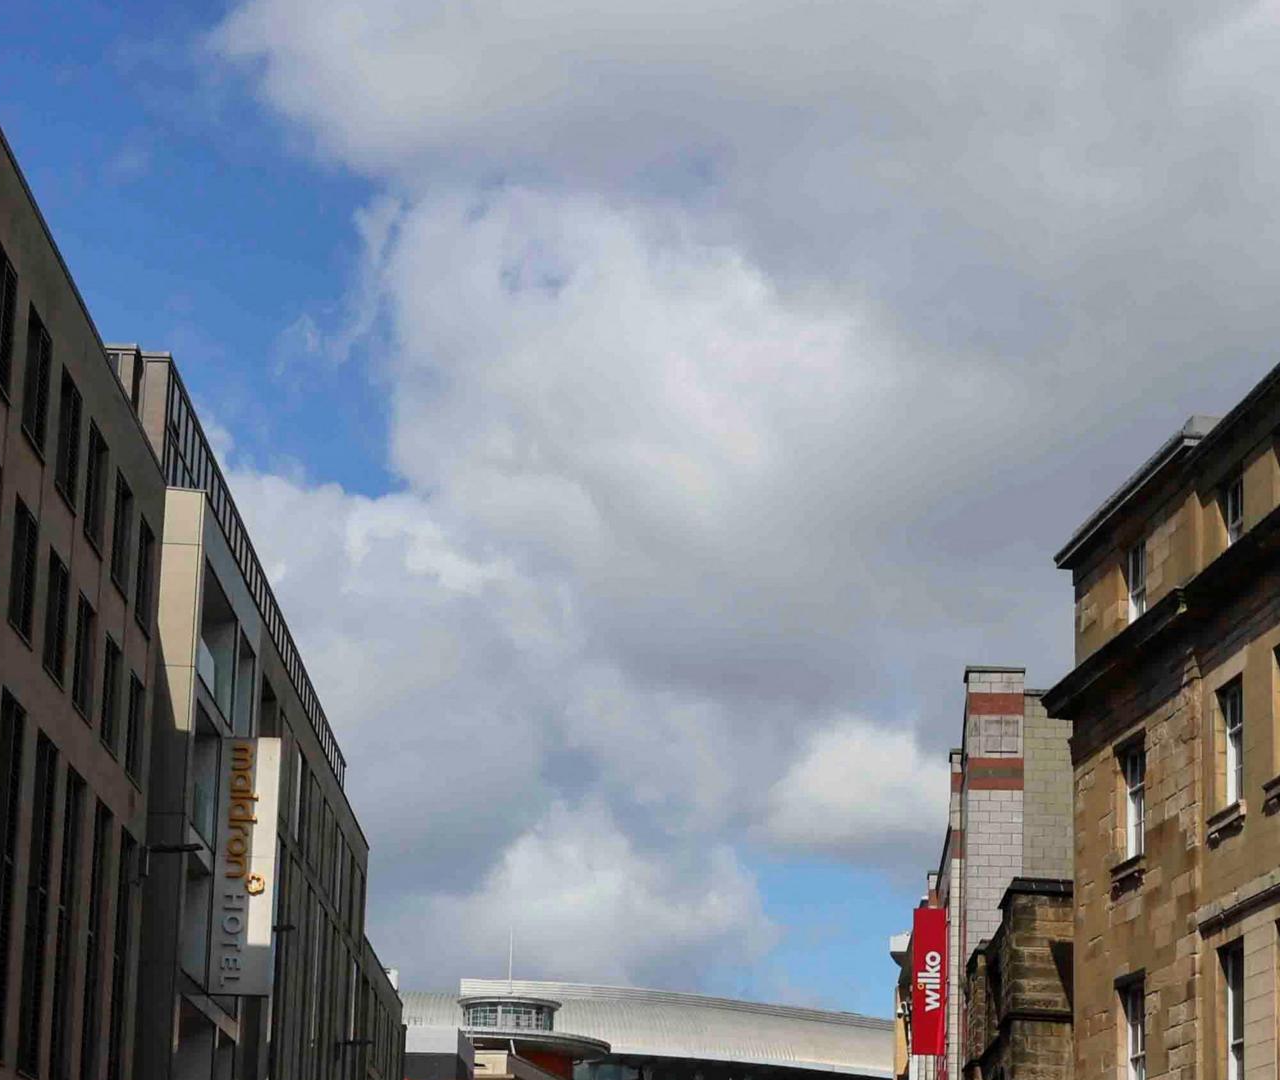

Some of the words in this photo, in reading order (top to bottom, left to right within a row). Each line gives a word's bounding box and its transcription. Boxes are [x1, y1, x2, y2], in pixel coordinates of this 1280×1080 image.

[225, 744, 258, 879] maldron
[220, 894, 244, 986] HOTEL
[917, 951, 942, 1012] wilko
